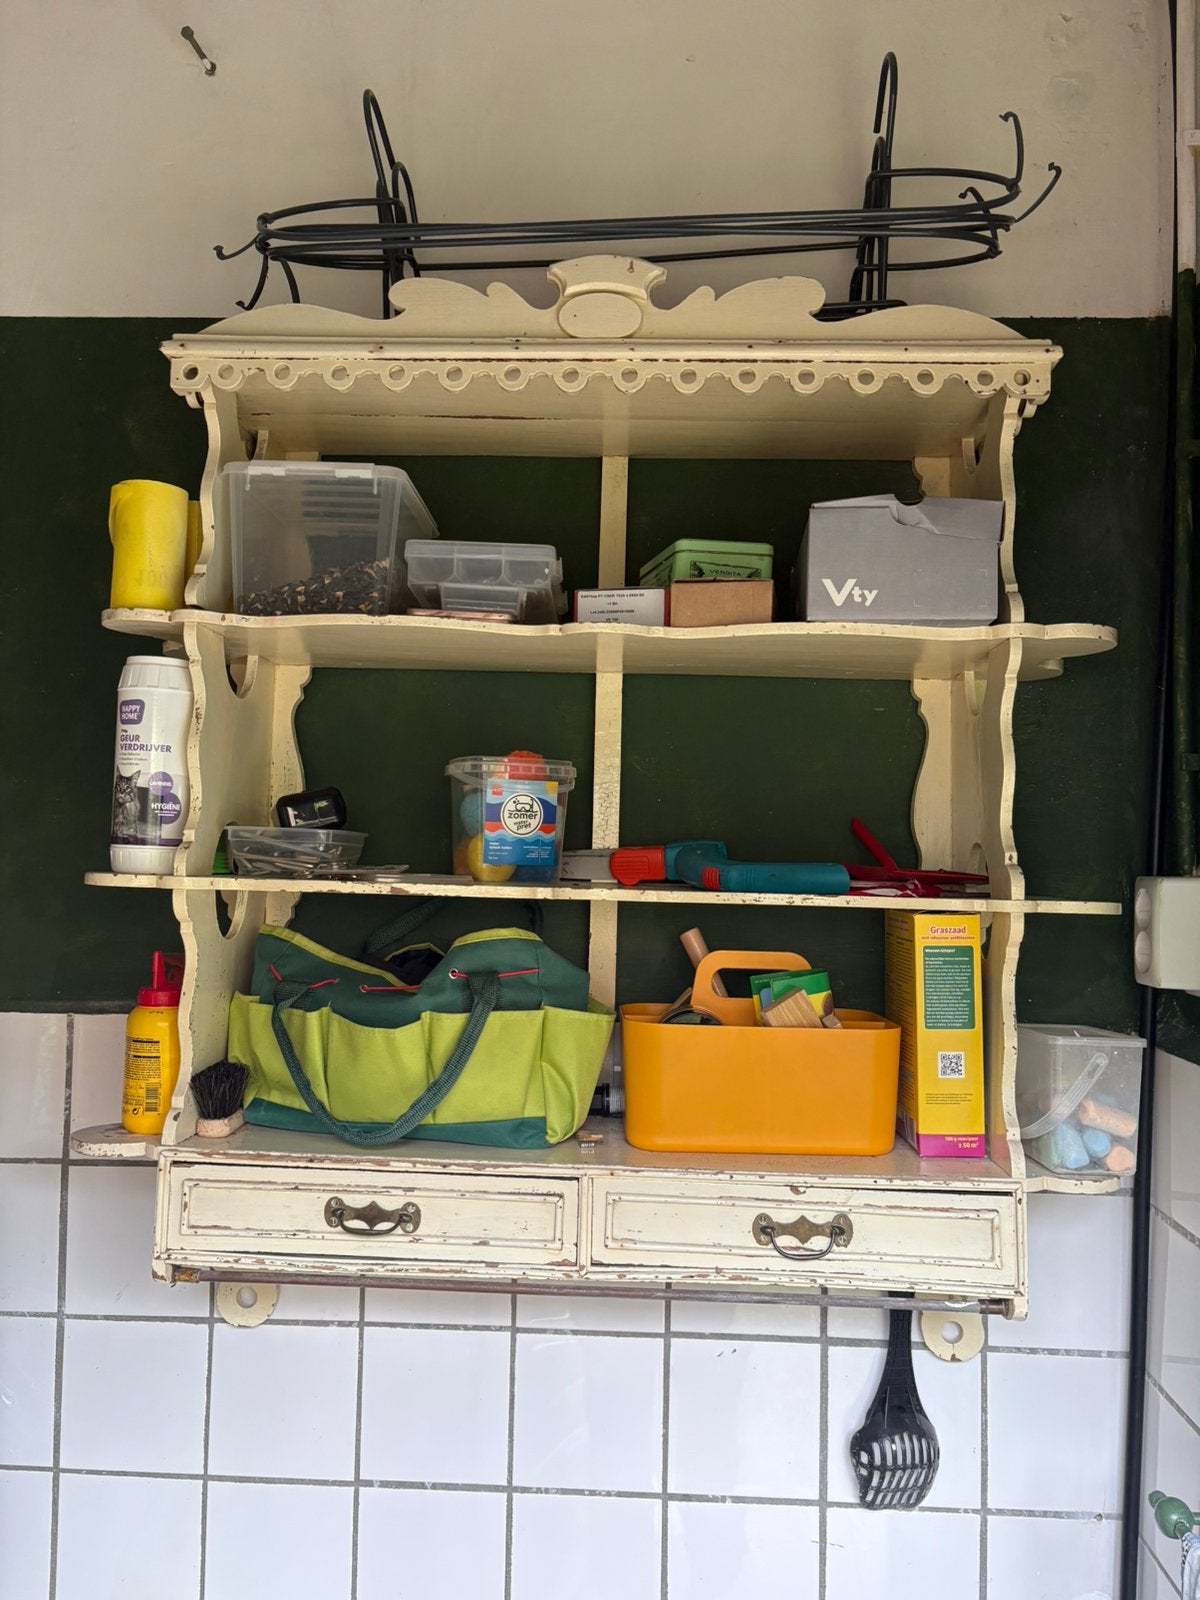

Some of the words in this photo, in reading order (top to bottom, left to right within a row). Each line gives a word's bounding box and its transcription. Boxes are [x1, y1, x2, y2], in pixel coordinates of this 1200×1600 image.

[710, 569, 741, 577] VENDITA
[821, 578, 879, 607] Vty
[121, 704, 141, 713] HAPPY
[121, 712, 138, 720] HOME
[120, 743, 172, 753] VERDRIJVER
[508, 812, 538, 820] zomer
[517, 823, 531, 831] pret
[930, 925, 966, 934] Graszaad
